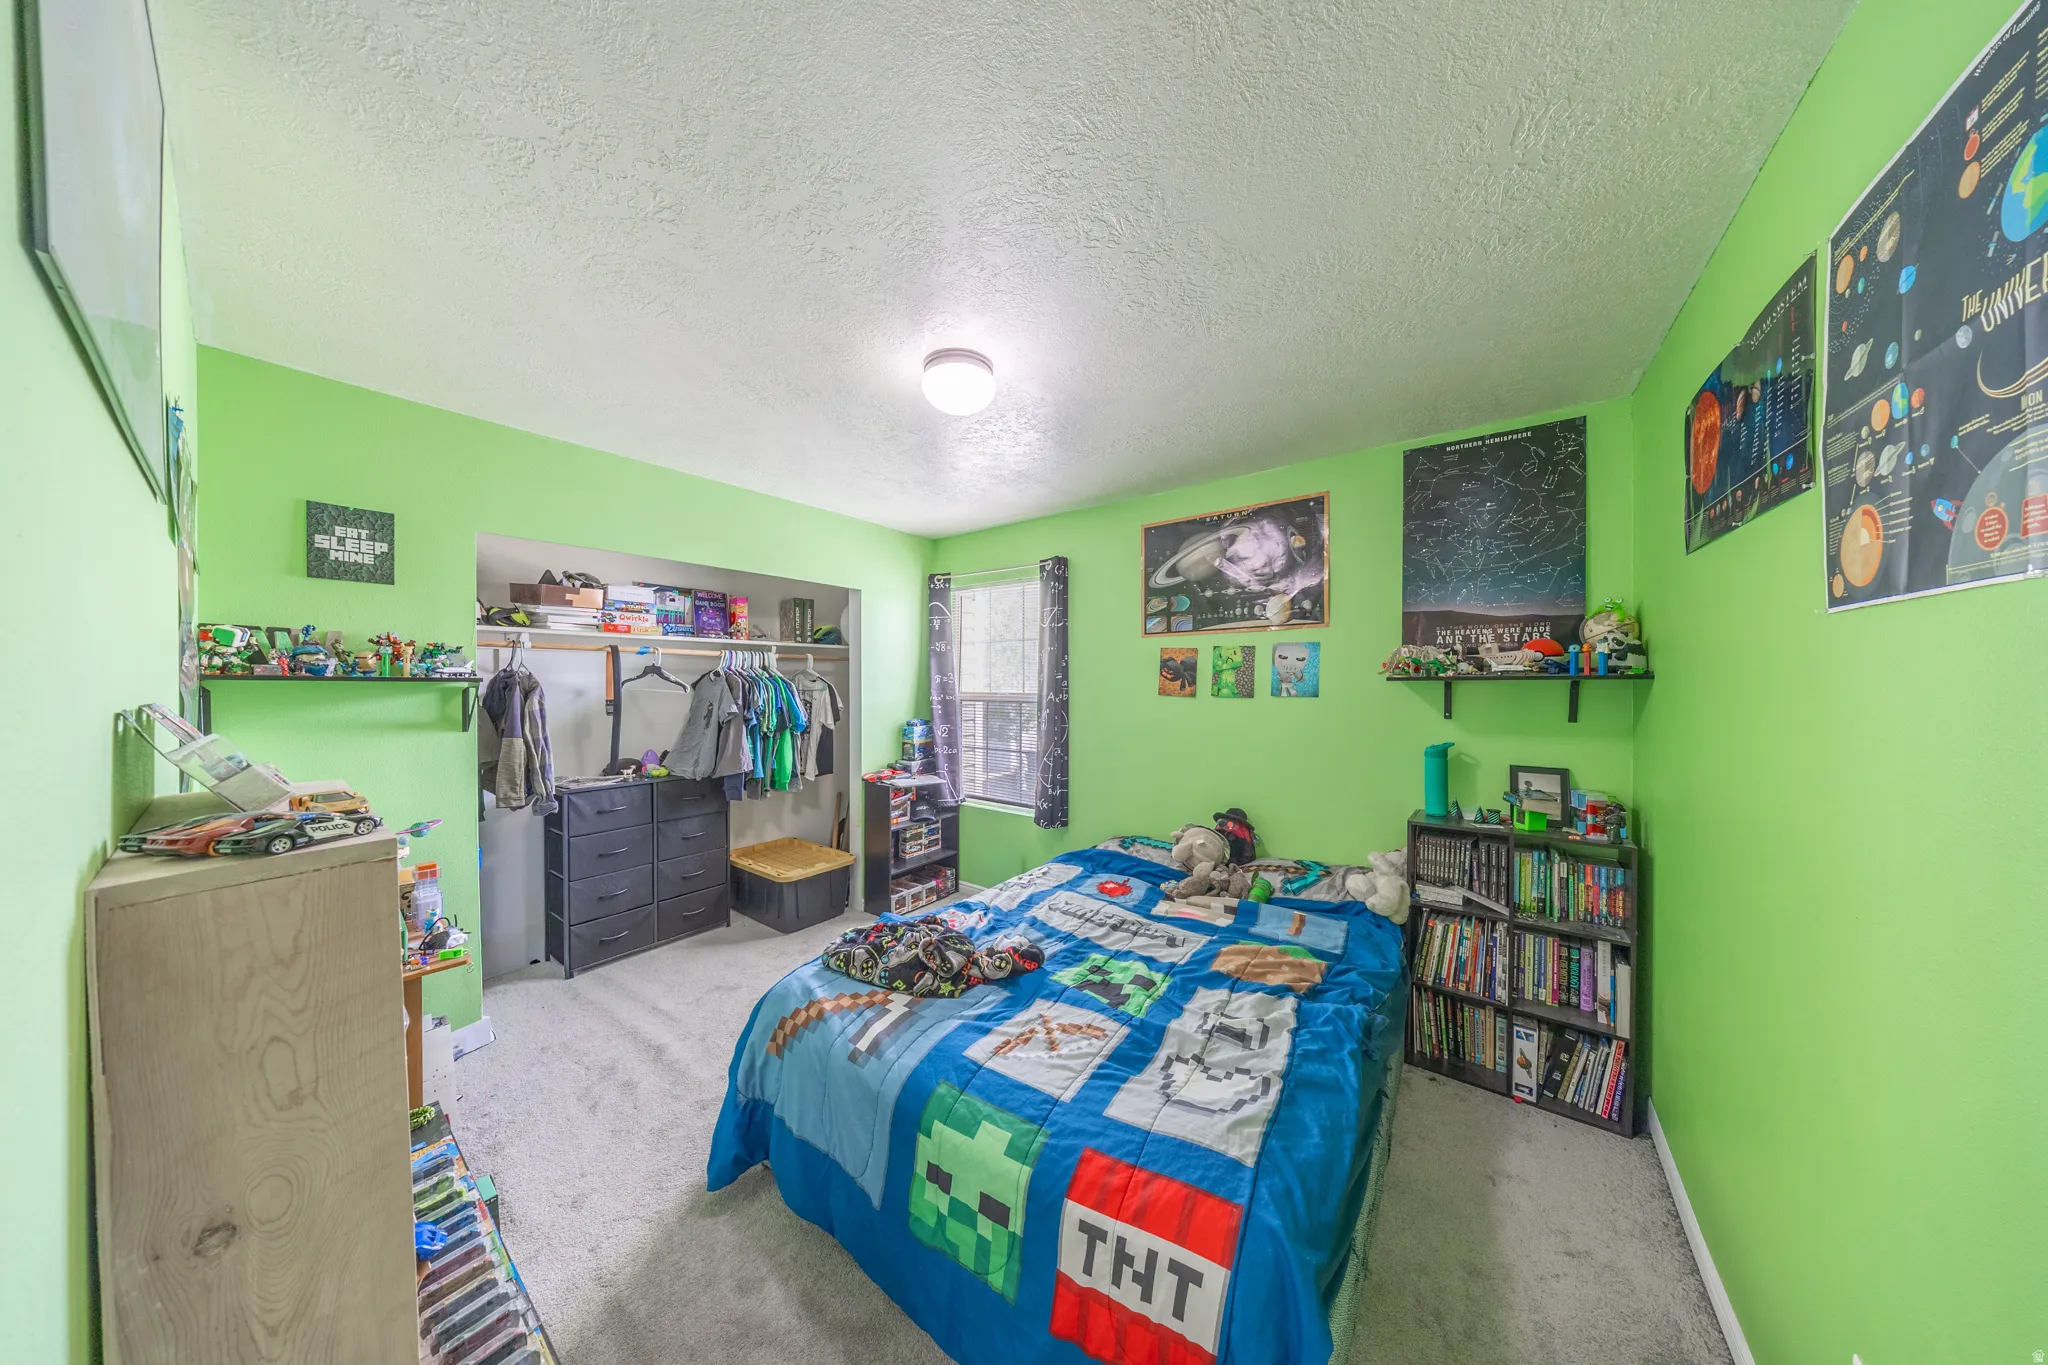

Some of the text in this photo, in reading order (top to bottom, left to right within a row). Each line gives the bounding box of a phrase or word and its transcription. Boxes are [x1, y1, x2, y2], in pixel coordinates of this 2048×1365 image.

[1973, 40, 2002, 77] Wonders
[2012, 0, 2041, 35] Learning
[1962, 289, 1983, 322] THE
[1446, 431, 1532, 452] NORTHERN HEMISPHERE
[1205, 510, 1248, 522] SATURN
[334, 525, 369, 540] EAT
[314, 534, 389, 555] SLEEP
[329, 549, 375, 565] MINE
[697, 591, 723, 600] WELCOME
[619, 613, 649, 623] Qwirkle
[1436, 632, 1551, 644] AND THE STARS
[310, 822, 351, 833] POLICE
[1569, 962, 1580, 989] BIOLOGY
[1078, 1218, 1204, 1323] TNT
